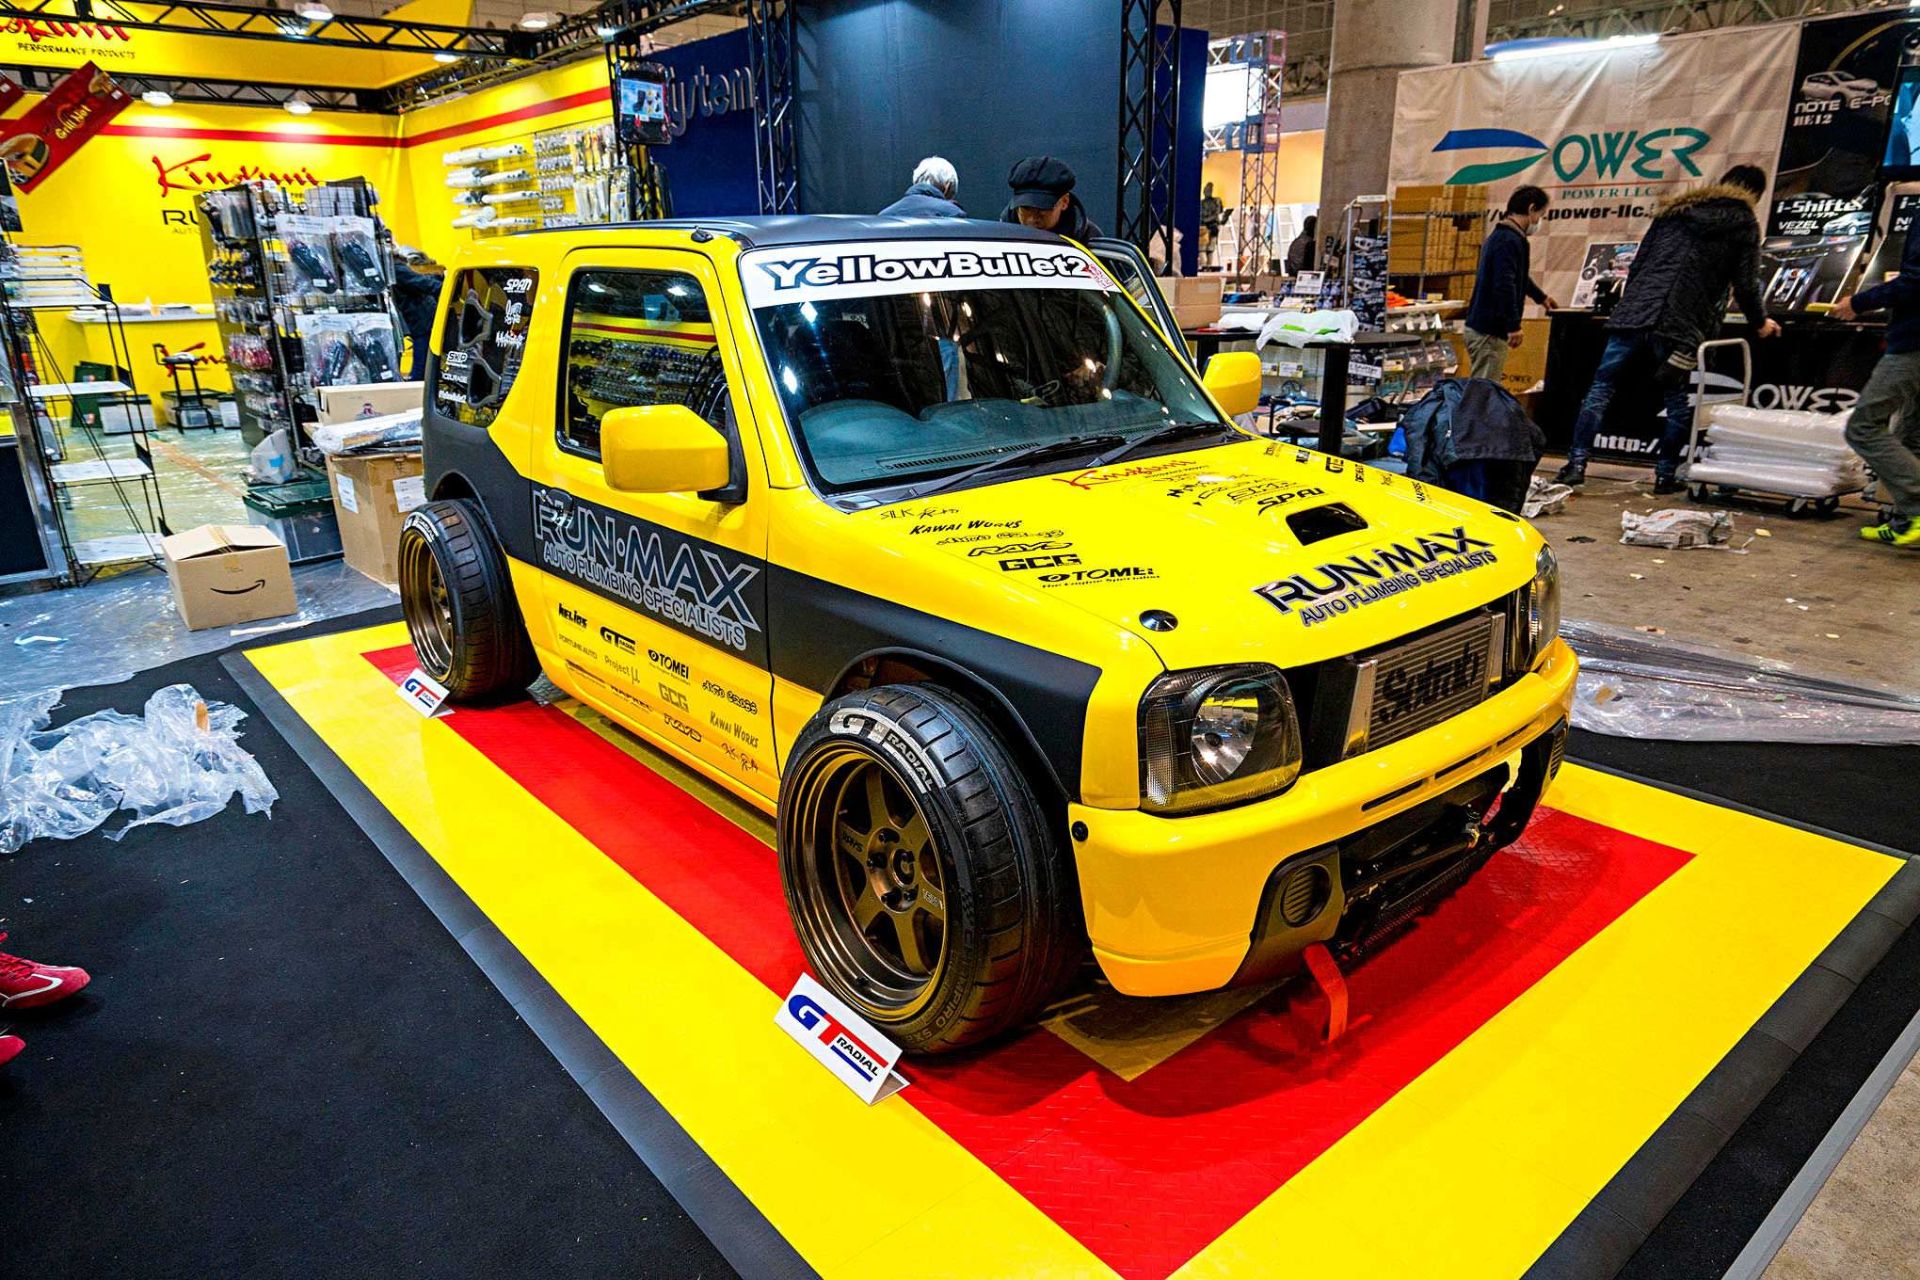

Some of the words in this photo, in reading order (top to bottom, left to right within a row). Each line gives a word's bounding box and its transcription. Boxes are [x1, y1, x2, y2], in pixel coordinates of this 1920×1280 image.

[17, 42, 87, 56] PERFORMANCE
[91, 48, 136, 60] PRODUCTS
[667, 65, 755, 137] ystem
[1793, 99, 1841, 114] NOTE
[1562, 188, 1620, 200] POWER
[1624, 187, 1652, 198] LLC
[1778, 220, 1820, 231] VEZEL
[998, 553, 1082, 573] GCG
[1072, 566, 1155, 581] TOMEI
[542, 540, 577, 575] AUTO
[577, 554, 643, 605] PLUMBING
[643, 584, 747, 651] SPECIALISTS
[1299, 595, 1349, 627] AUTO
[1345, 572, 1422, 609] PLUMBING
[1418, 550, 1499, 585] SPECIALISTS
[604, 655, 630, 676] Project
[659, 653, 689, 679] TOMEI
[405, 678, 436, 699] GT
[659, 682, 690, 713] GCG
[710, 710, 731, 734] KAWAI
[886, 732, 935, 792] RADIAL
[836, 1036, 879, 1077] RADIAL
